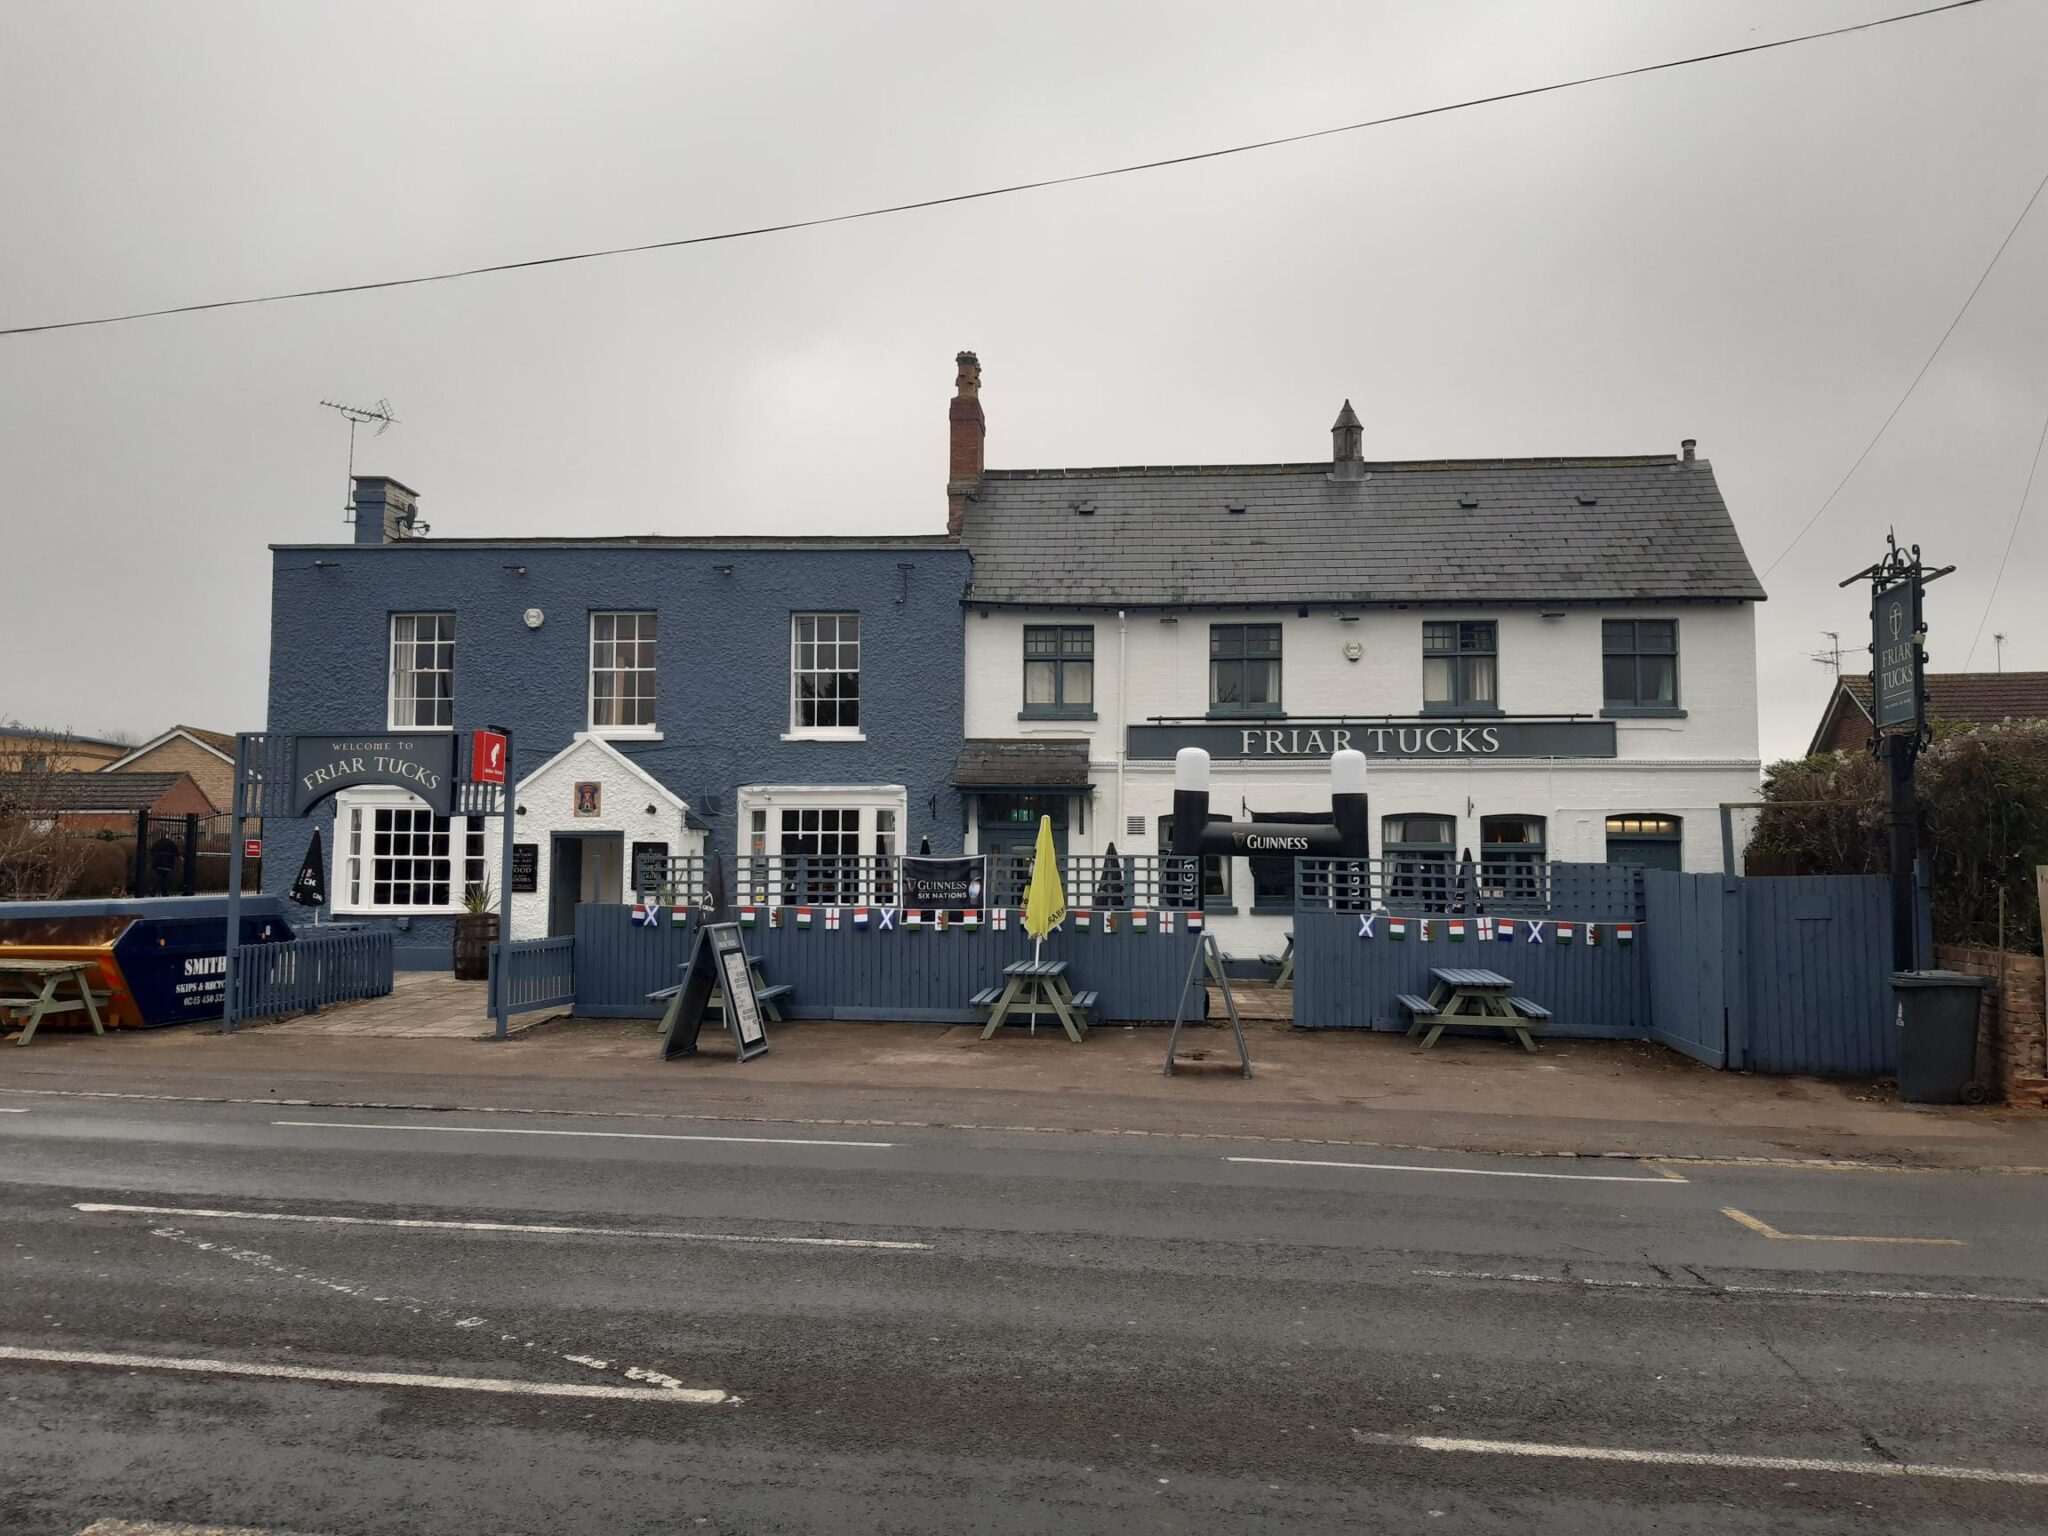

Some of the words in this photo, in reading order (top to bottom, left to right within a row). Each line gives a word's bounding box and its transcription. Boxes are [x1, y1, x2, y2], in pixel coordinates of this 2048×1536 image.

[1881, 642, 1912, 668] FRIAR
[1881, 664, 1913, 690] TUCKS
[332, 742, 391, 750] WELCOME
[398, 741, 414, 750] TO
[1240, 729, 1351, 754] FRIAR
[1367, 727, 1500, 753] TUCKS
[303, 757, 366, 791] FRIAR
[374, 756, 441, 789] TUCKS
[1246, 834, 1308, 850] GUINNESS
[917, 880, 967, 890] GUINNESS
[176, 982, 197, 993] SKIPS
[204, 980, 226, 991] RECYC
